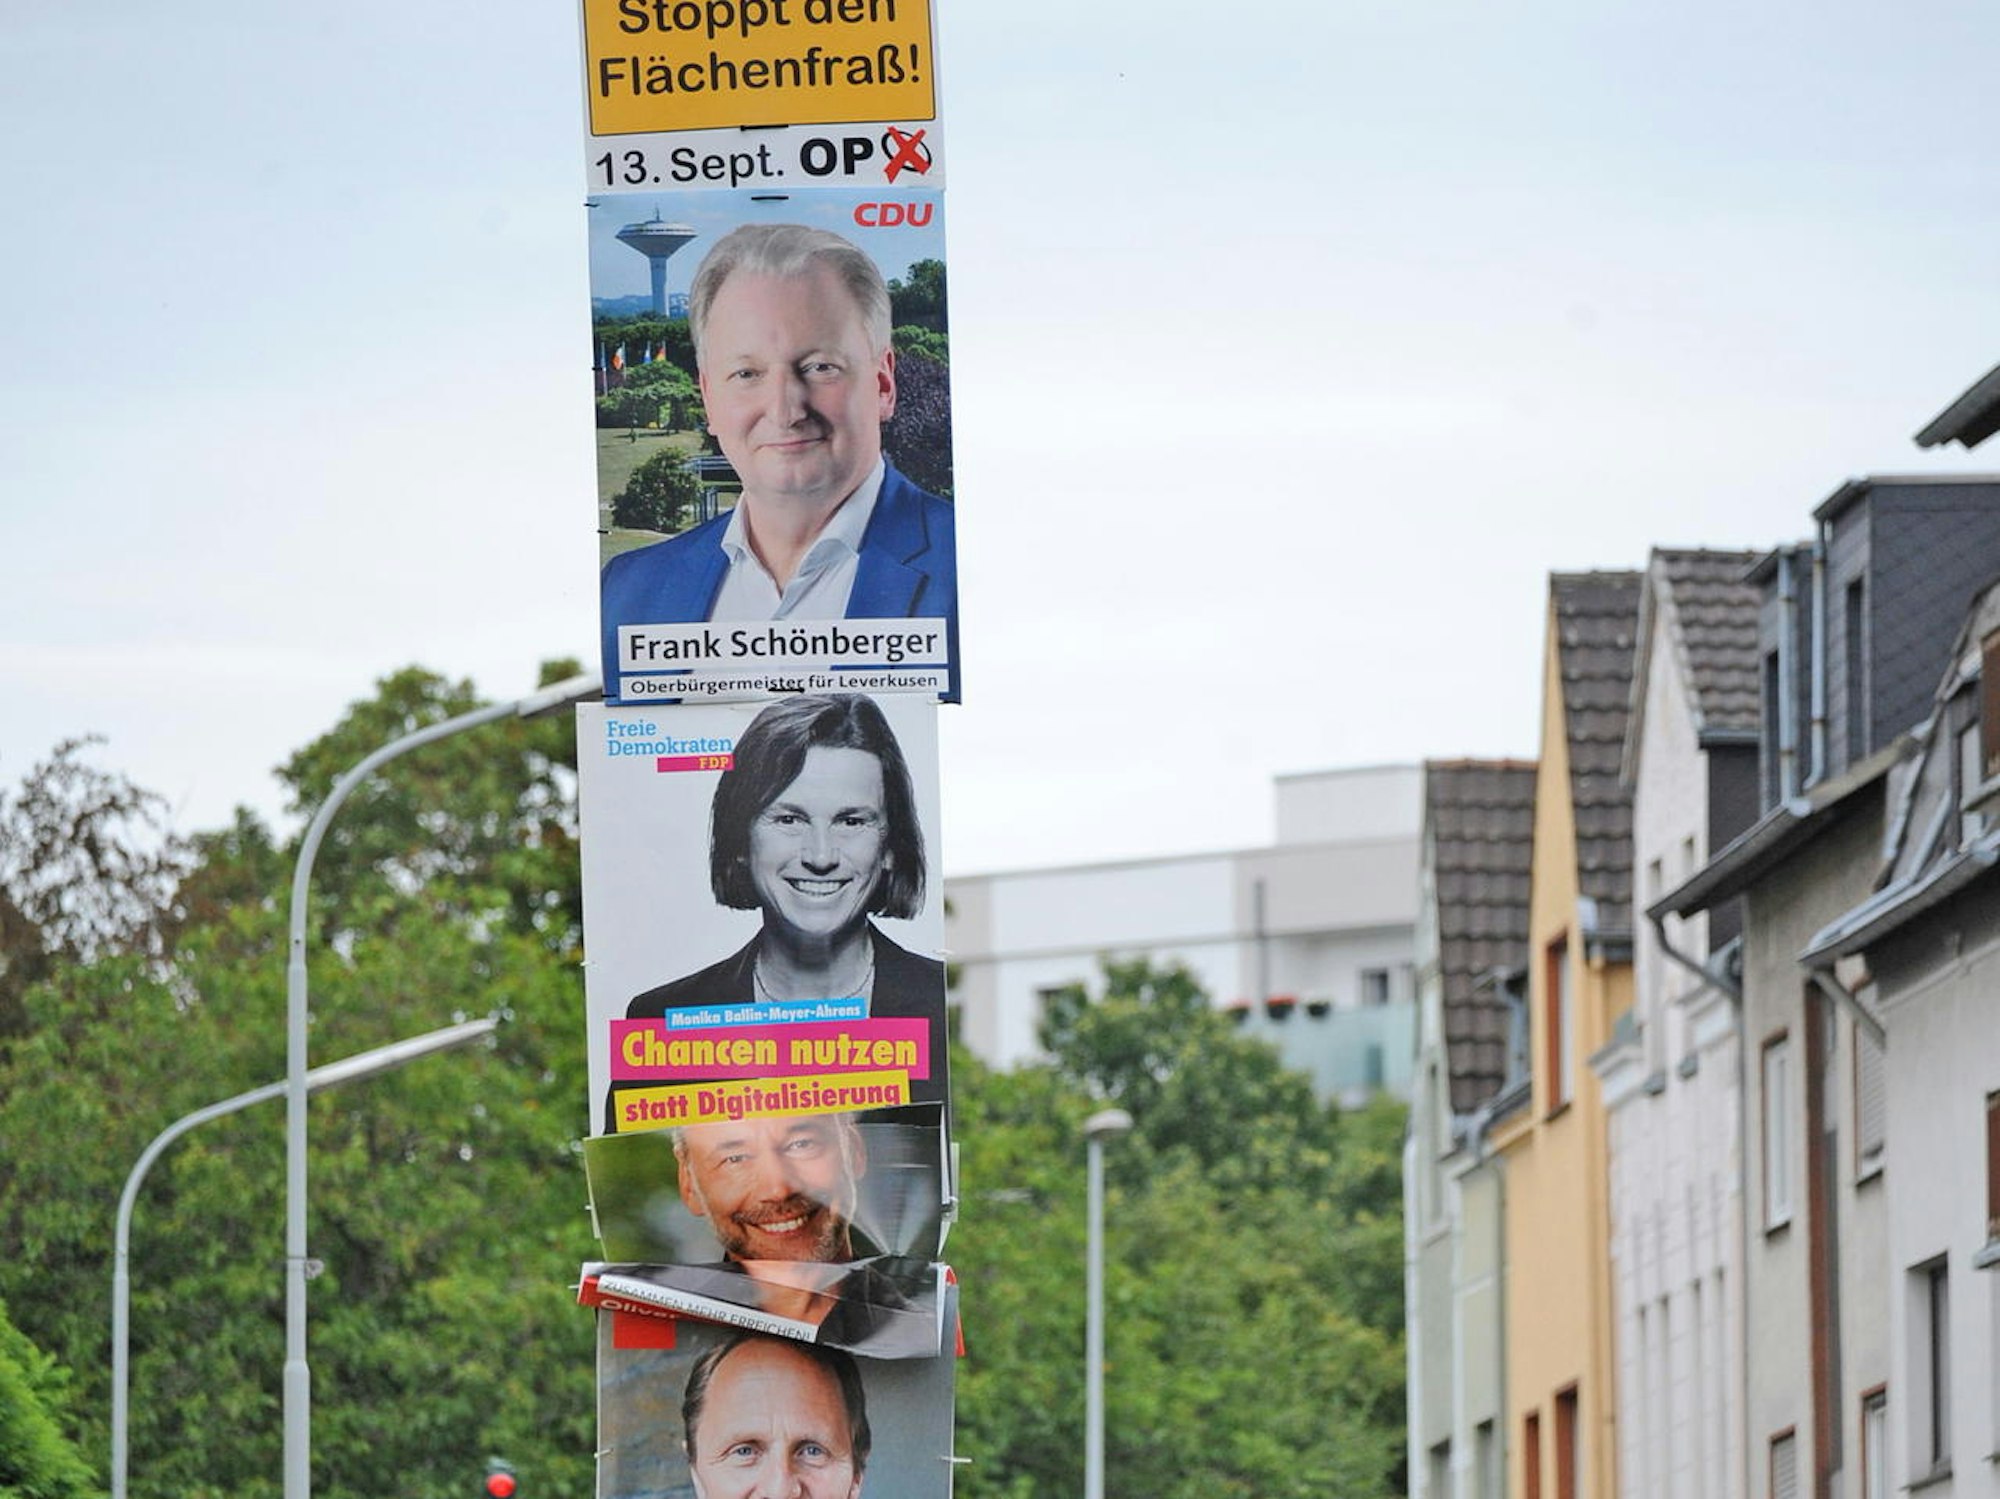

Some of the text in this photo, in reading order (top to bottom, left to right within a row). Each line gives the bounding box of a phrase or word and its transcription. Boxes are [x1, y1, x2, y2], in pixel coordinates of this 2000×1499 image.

[618, 0, 896, 39] Stoppt den
[600, 43, 920, 97] Flächenfraß!
[595, 150, 660, 186] 13.
[670, 143, 784, 187] Sept.
[853, 202, 934, 228] CDU
[630, 626, 938, 663] Frank Schönberger
[631, 674, 938, 695] Oberbürgermeister für Leverkusen
[607, 718, 657, 737] Freie
[608, 736, 733, 756] Demokraten
[699, 756, 729, 769] FDP
[671, 1003, 861, 1027] Monika Ballin-Meyer-Ahrens
[622, 1028, 917, 1067] Chancen nutzen
[625, 1081, 900, 1122] statt Digitalisierung
[686, 1302, 727, 1321] MEHR
